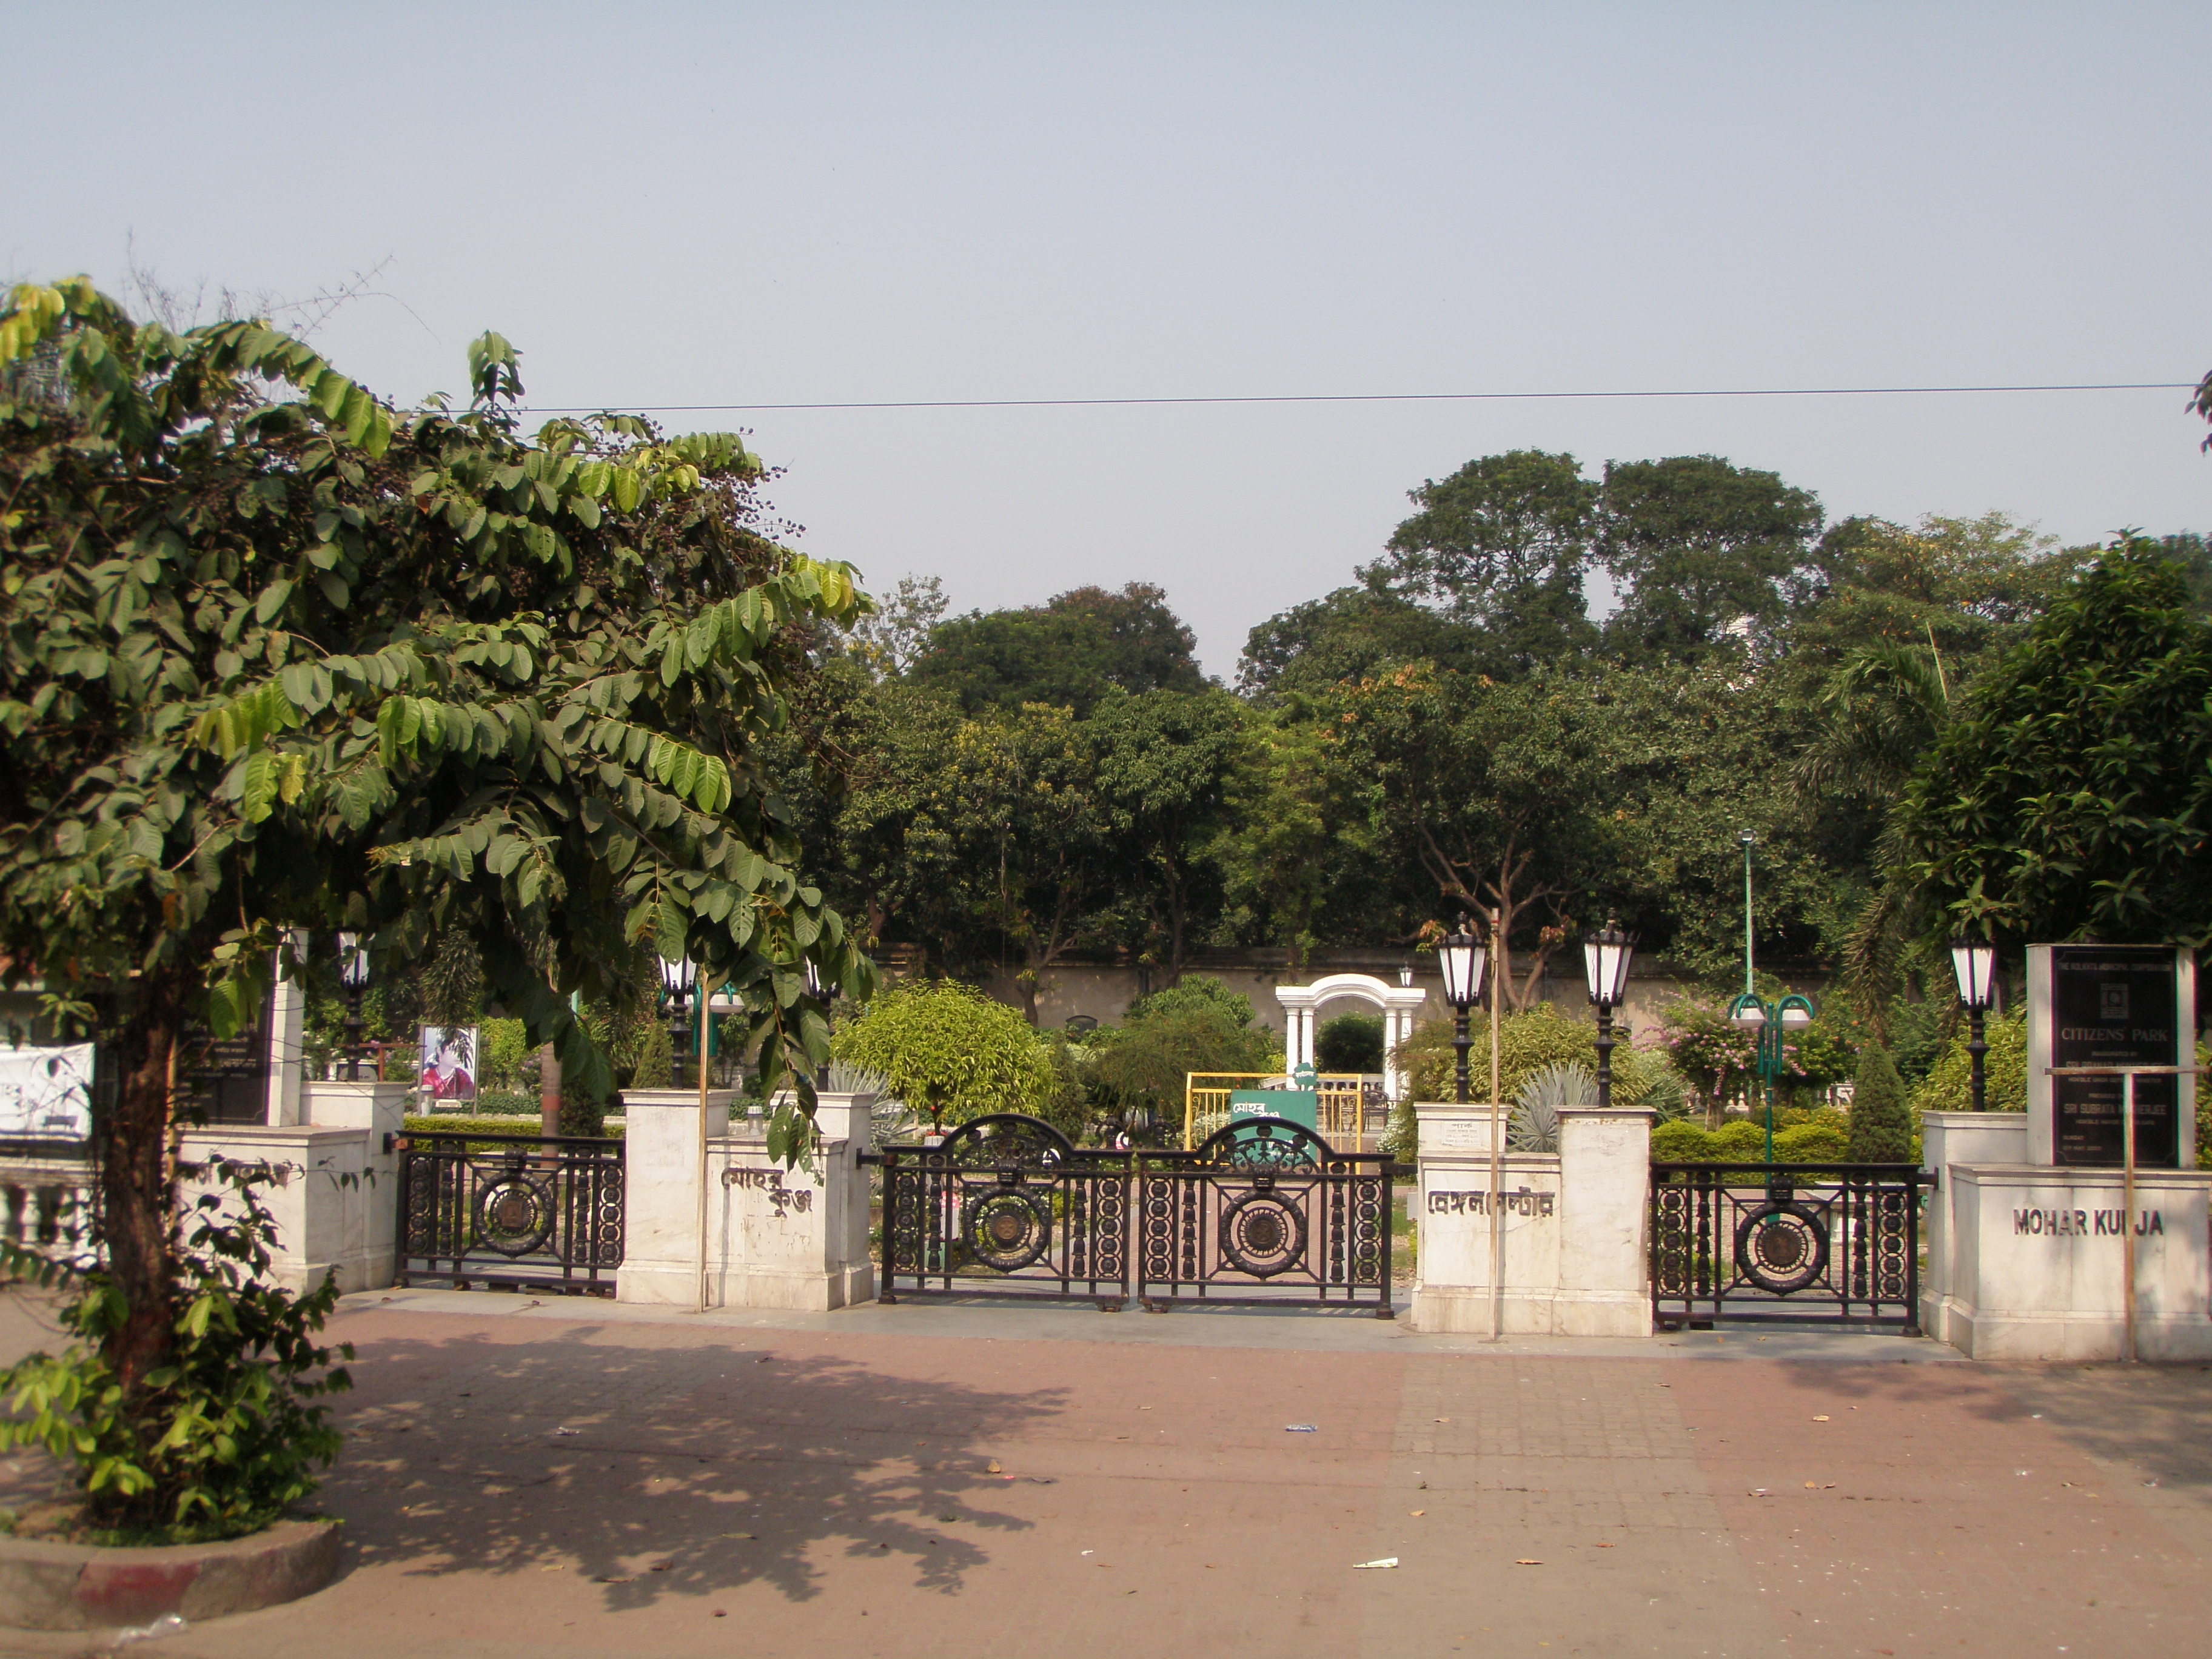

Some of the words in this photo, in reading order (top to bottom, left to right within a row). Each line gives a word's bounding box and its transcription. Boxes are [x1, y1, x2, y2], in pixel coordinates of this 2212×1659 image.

[2132, 1028, 2168, 1042] PARK
[2080, 1104, 2116, 1114] SUBRATA
[721, 1166, 785, 1191] মোহর
[768, 1188, 813, 1219] কুঞ্জ
[2013, 1208, 2087, 1236] MOHAR
[2093, 1209, 2163, 1236] KUJA
